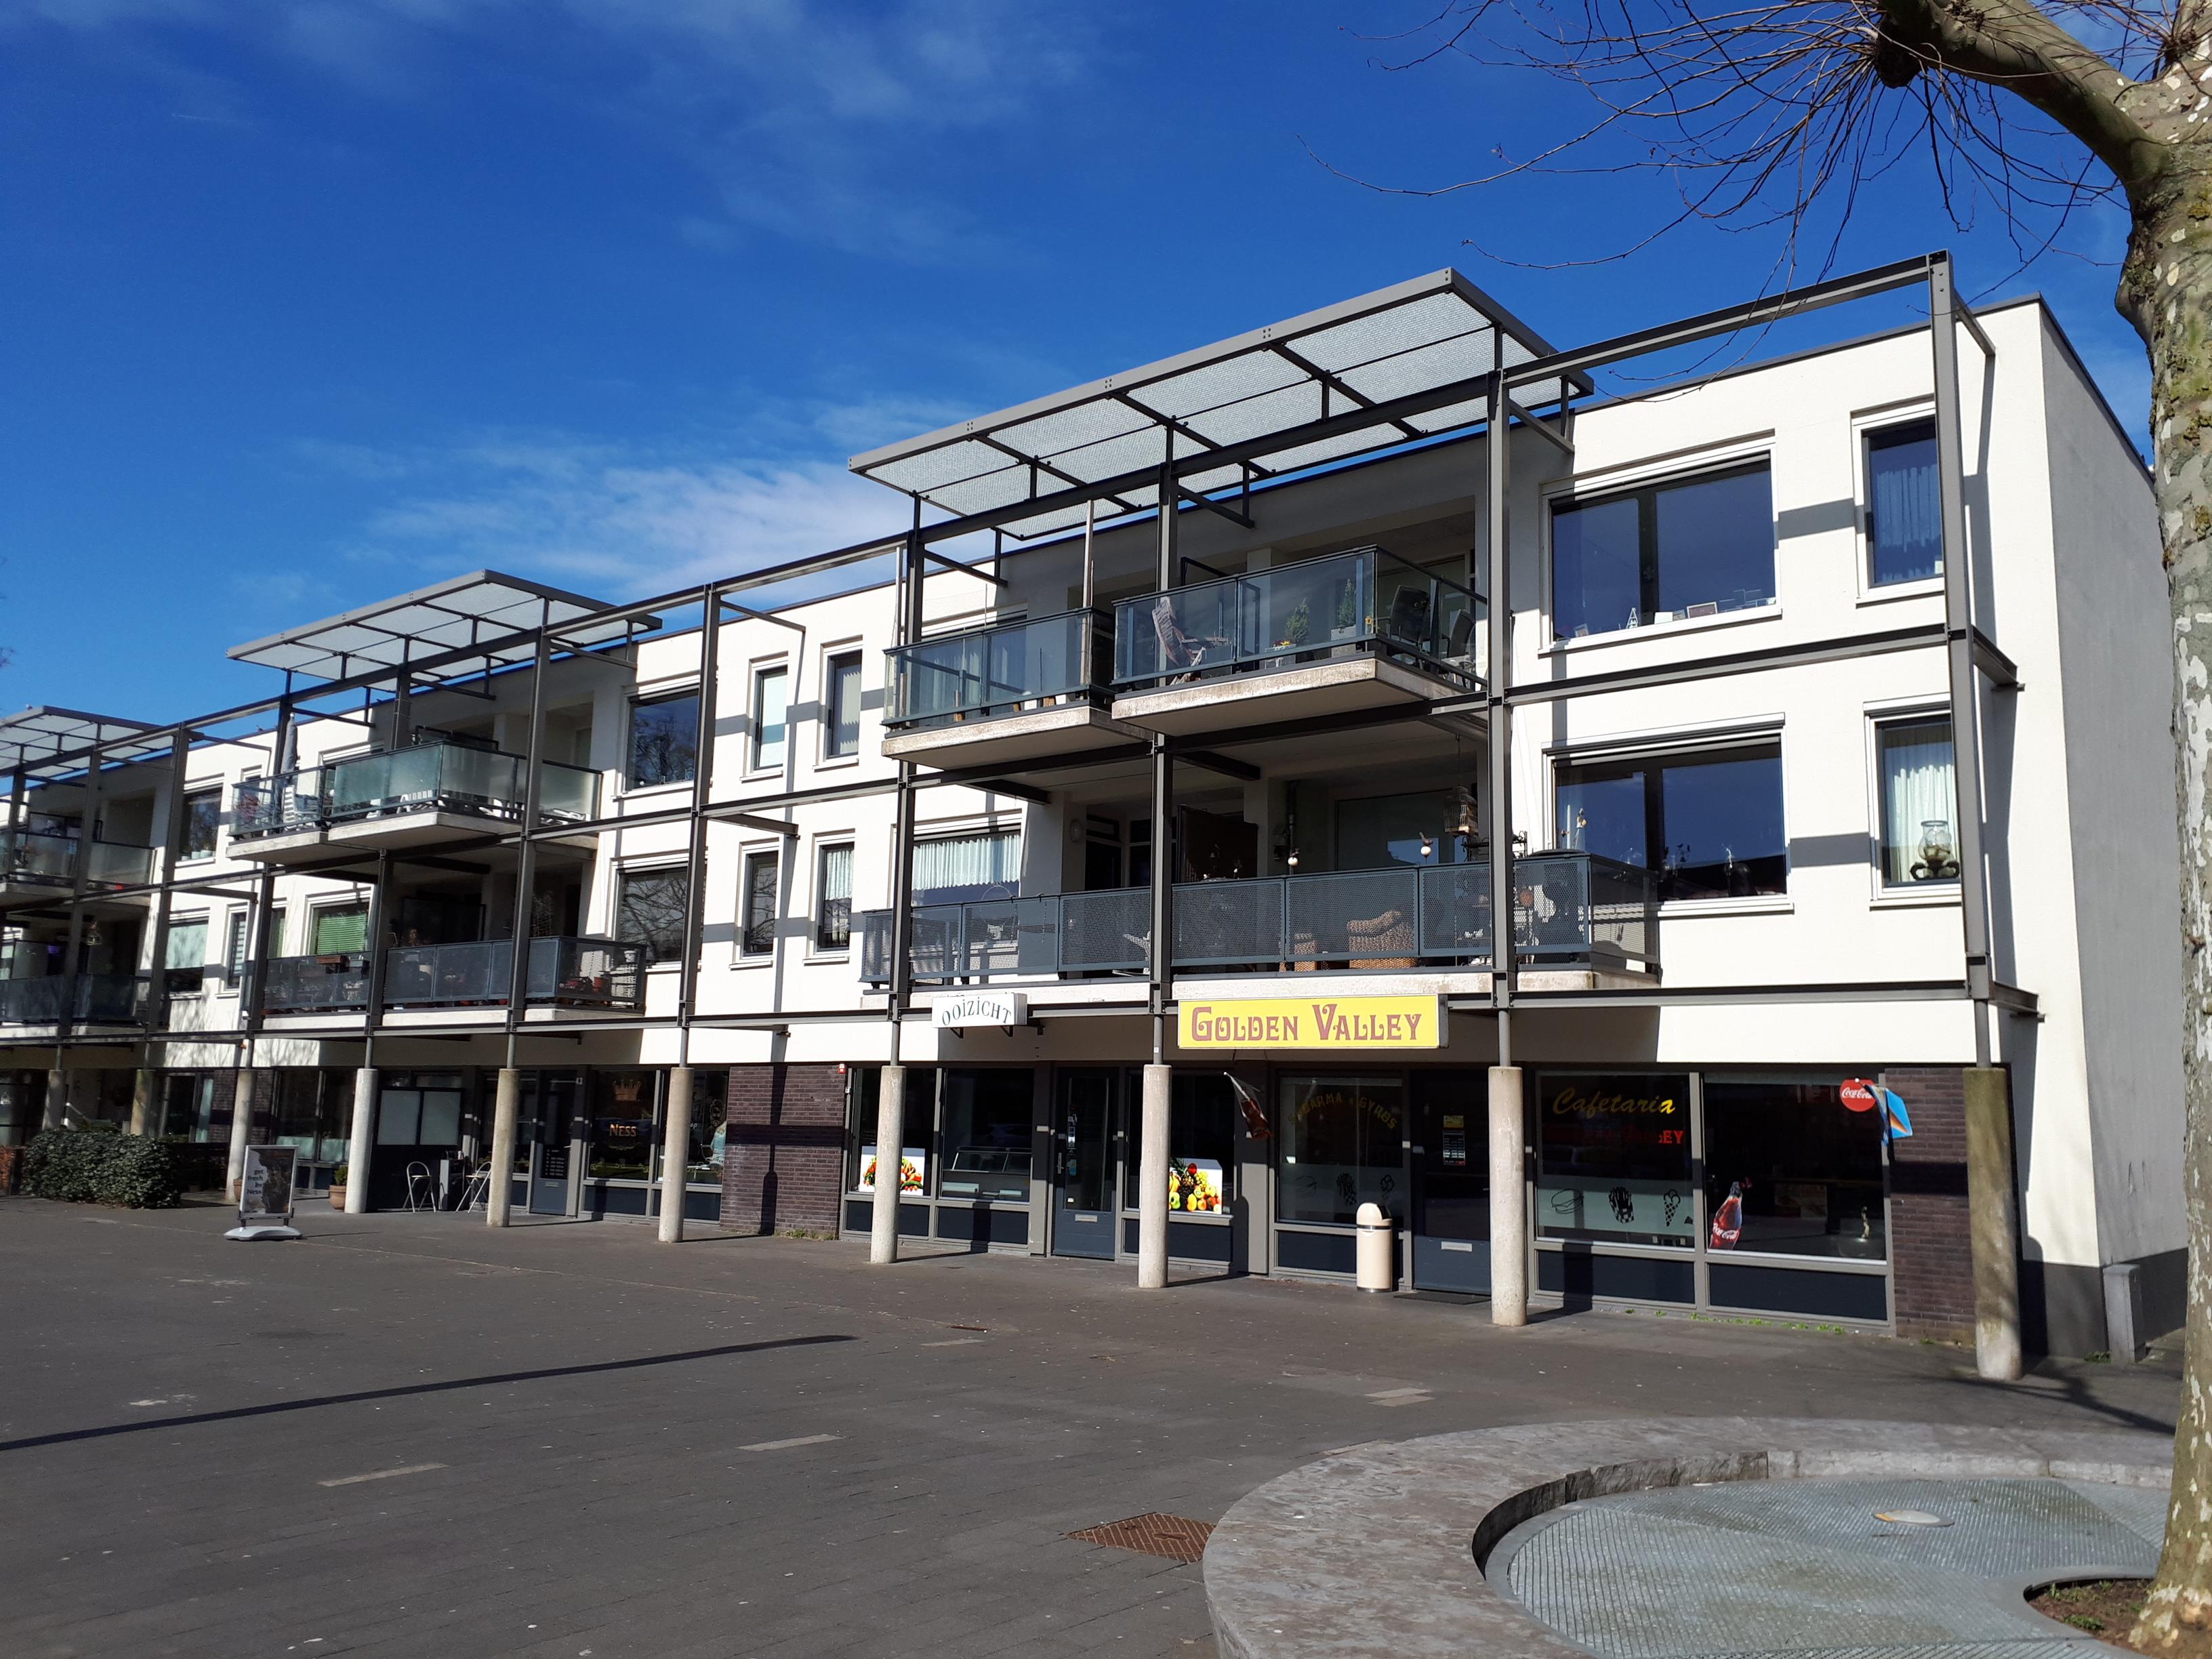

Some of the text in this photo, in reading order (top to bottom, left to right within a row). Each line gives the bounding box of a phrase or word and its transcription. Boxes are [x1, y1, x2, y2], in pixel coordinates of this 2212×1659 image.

[1191, 1003, 1422, 1042] GOLDEN VALLEY
[575, 1077, 583, 1085] 43
[1359, 1096, 1398, 1129] GYROS
[1552, 1086, 1676, 1120] Cafetaria
